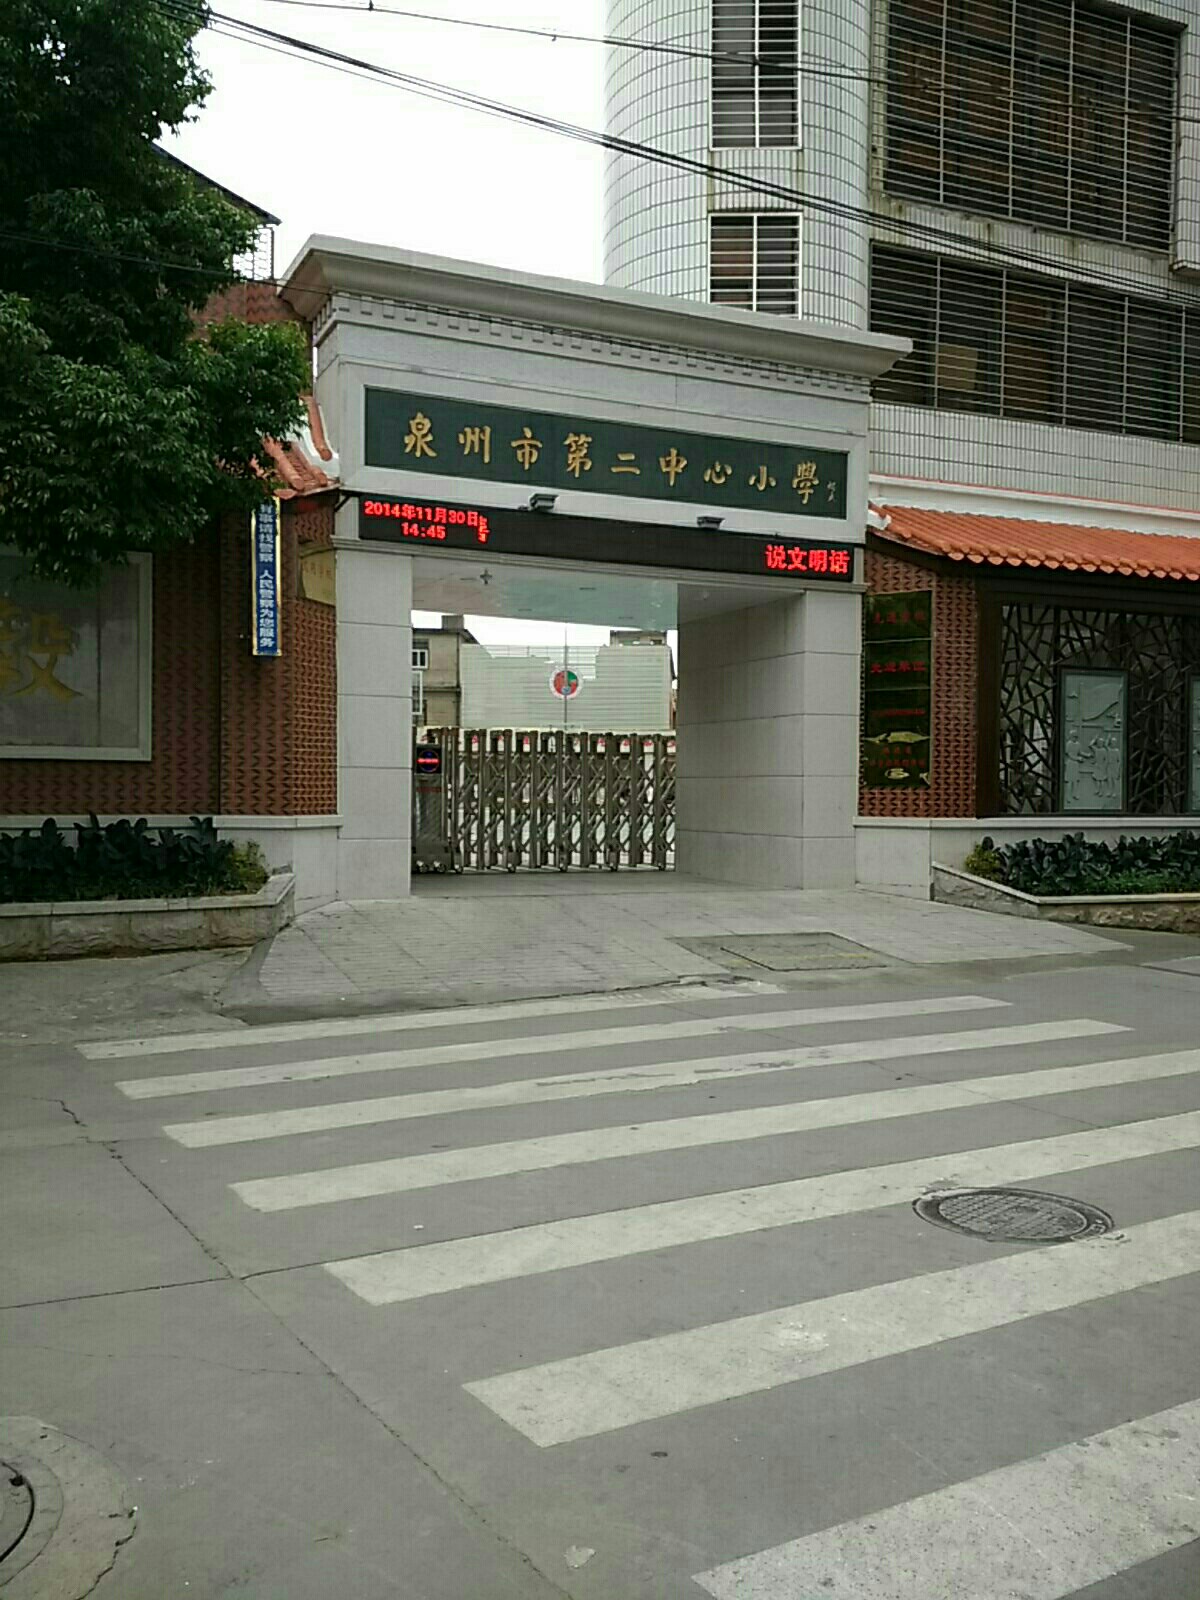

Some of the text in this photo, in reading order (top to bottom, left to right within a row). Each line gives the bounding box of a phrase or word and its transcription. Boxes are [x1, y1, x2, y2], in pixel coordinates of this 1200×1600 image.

[403, 411, 820, 505] 泉州市第二中心小學
[364, 501, 479, 527] 2014年11月30日
[401, 522, 446, 540] 14:45
[765, 544, 850, 574] 说文明话
[259, 570, 275, 648] 人民警察为您服务
